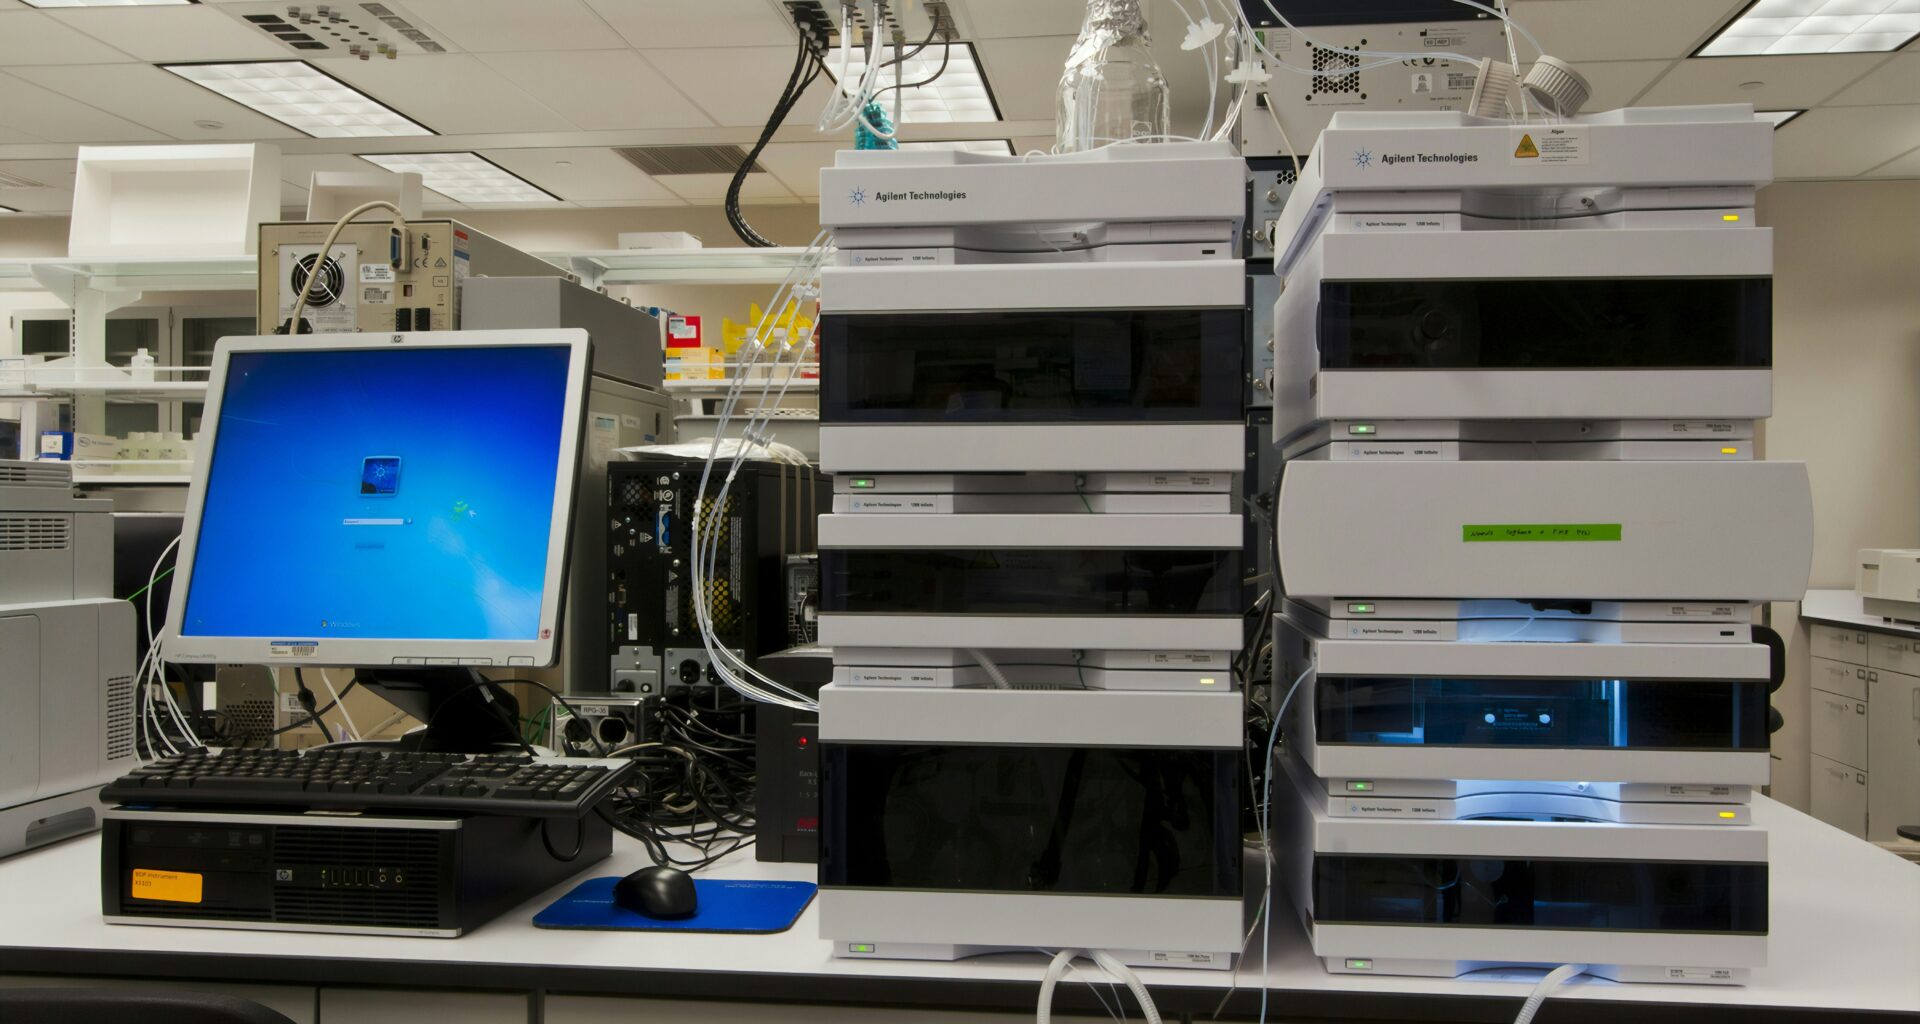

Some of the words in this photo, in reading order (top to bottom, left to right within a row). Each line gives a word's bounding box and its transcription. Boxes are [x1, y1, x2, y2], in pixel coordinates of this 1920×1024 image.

[1381, 154, 1415, 165] Agilent
[1417, 153, 1479, 164] Technologies
[875, 191, 907, 202] Agilent
[909, 190, 967, 201] Technologies
